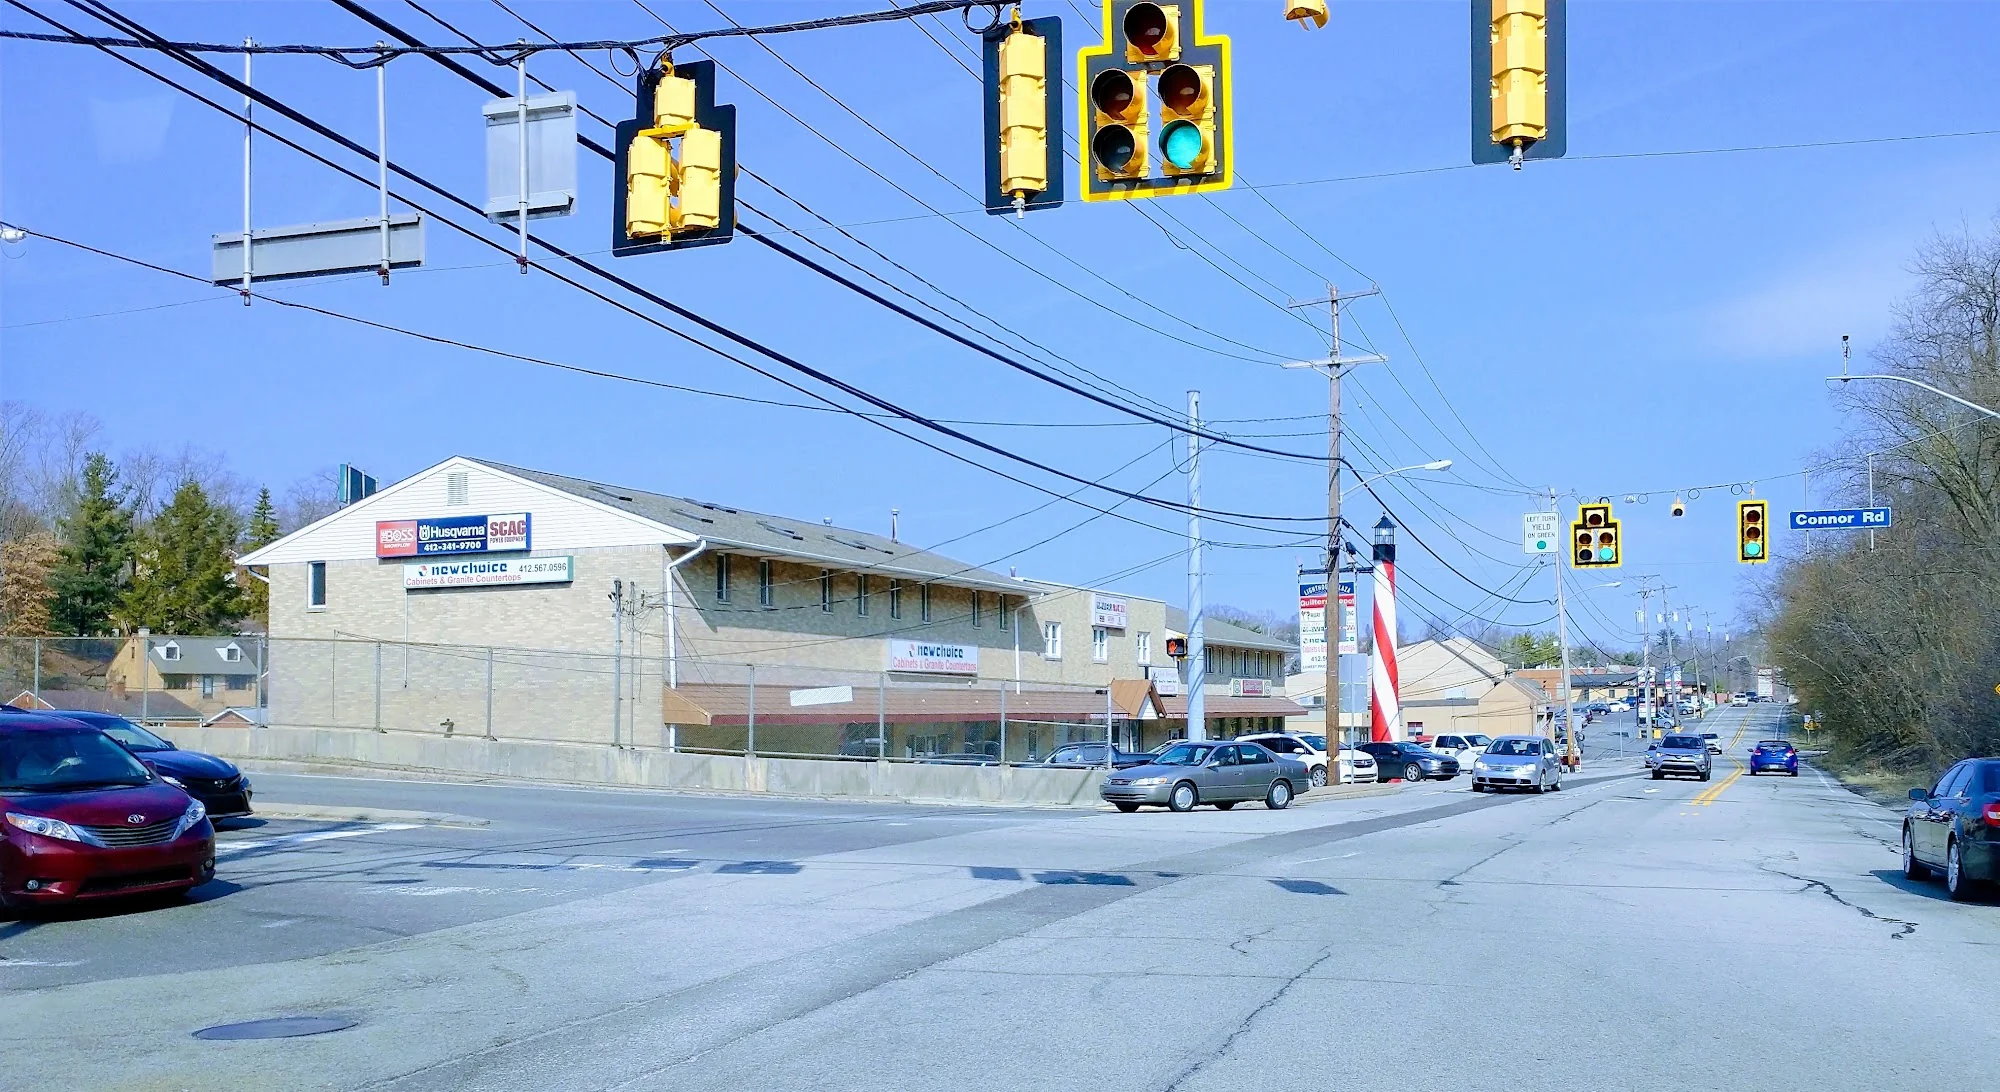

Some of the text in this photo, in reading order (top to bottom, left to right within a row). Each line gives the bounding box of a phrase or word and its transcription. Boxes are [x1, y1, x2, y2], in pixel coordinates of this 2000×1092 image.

[1795, 511, 1885, 526] Connor Rd
[431, 525, 485, 539] Husqvarna
[489, 520, 526, 537] SCAG
[386, 529, 414, 542] BOSS
[423, 541, 482, 551] 412-341-9700
[519, 563, 567, 573] 412.567.0596
[406, 573, 522, 586] Cabinets & Granite Countertops
[892, 657, 918, 669] Cabinets
[924, 659, 944, 669] Granite
[945, 660, 977, 671] Countertops
